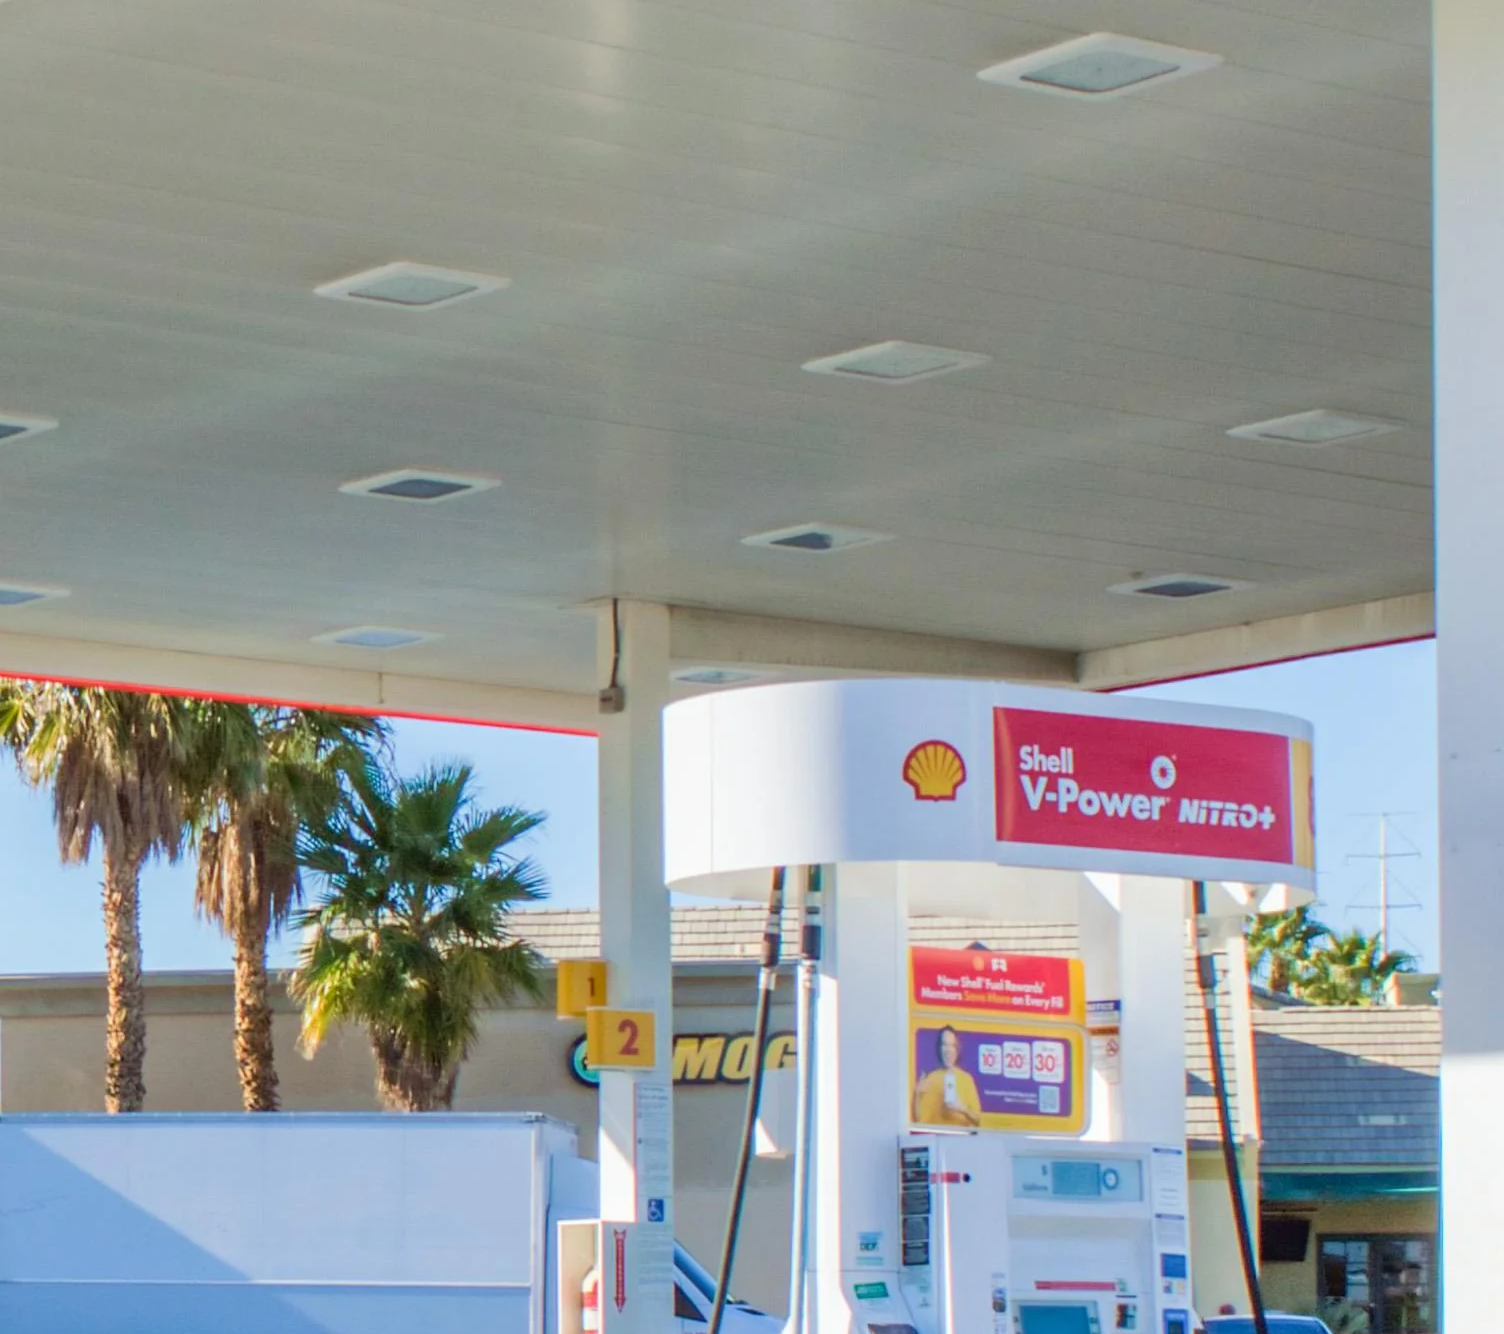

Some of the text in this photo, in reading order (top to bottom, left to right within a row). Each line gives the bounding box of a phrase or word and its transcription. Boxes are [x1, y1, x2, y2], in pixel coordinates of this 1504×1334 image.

[1019, 744, 1073, 774] Shell
[1020, 775, 1165, 821] V-Power
[588, 977, 596, 998] 1
[618, 1019, 639, 1056] 2
